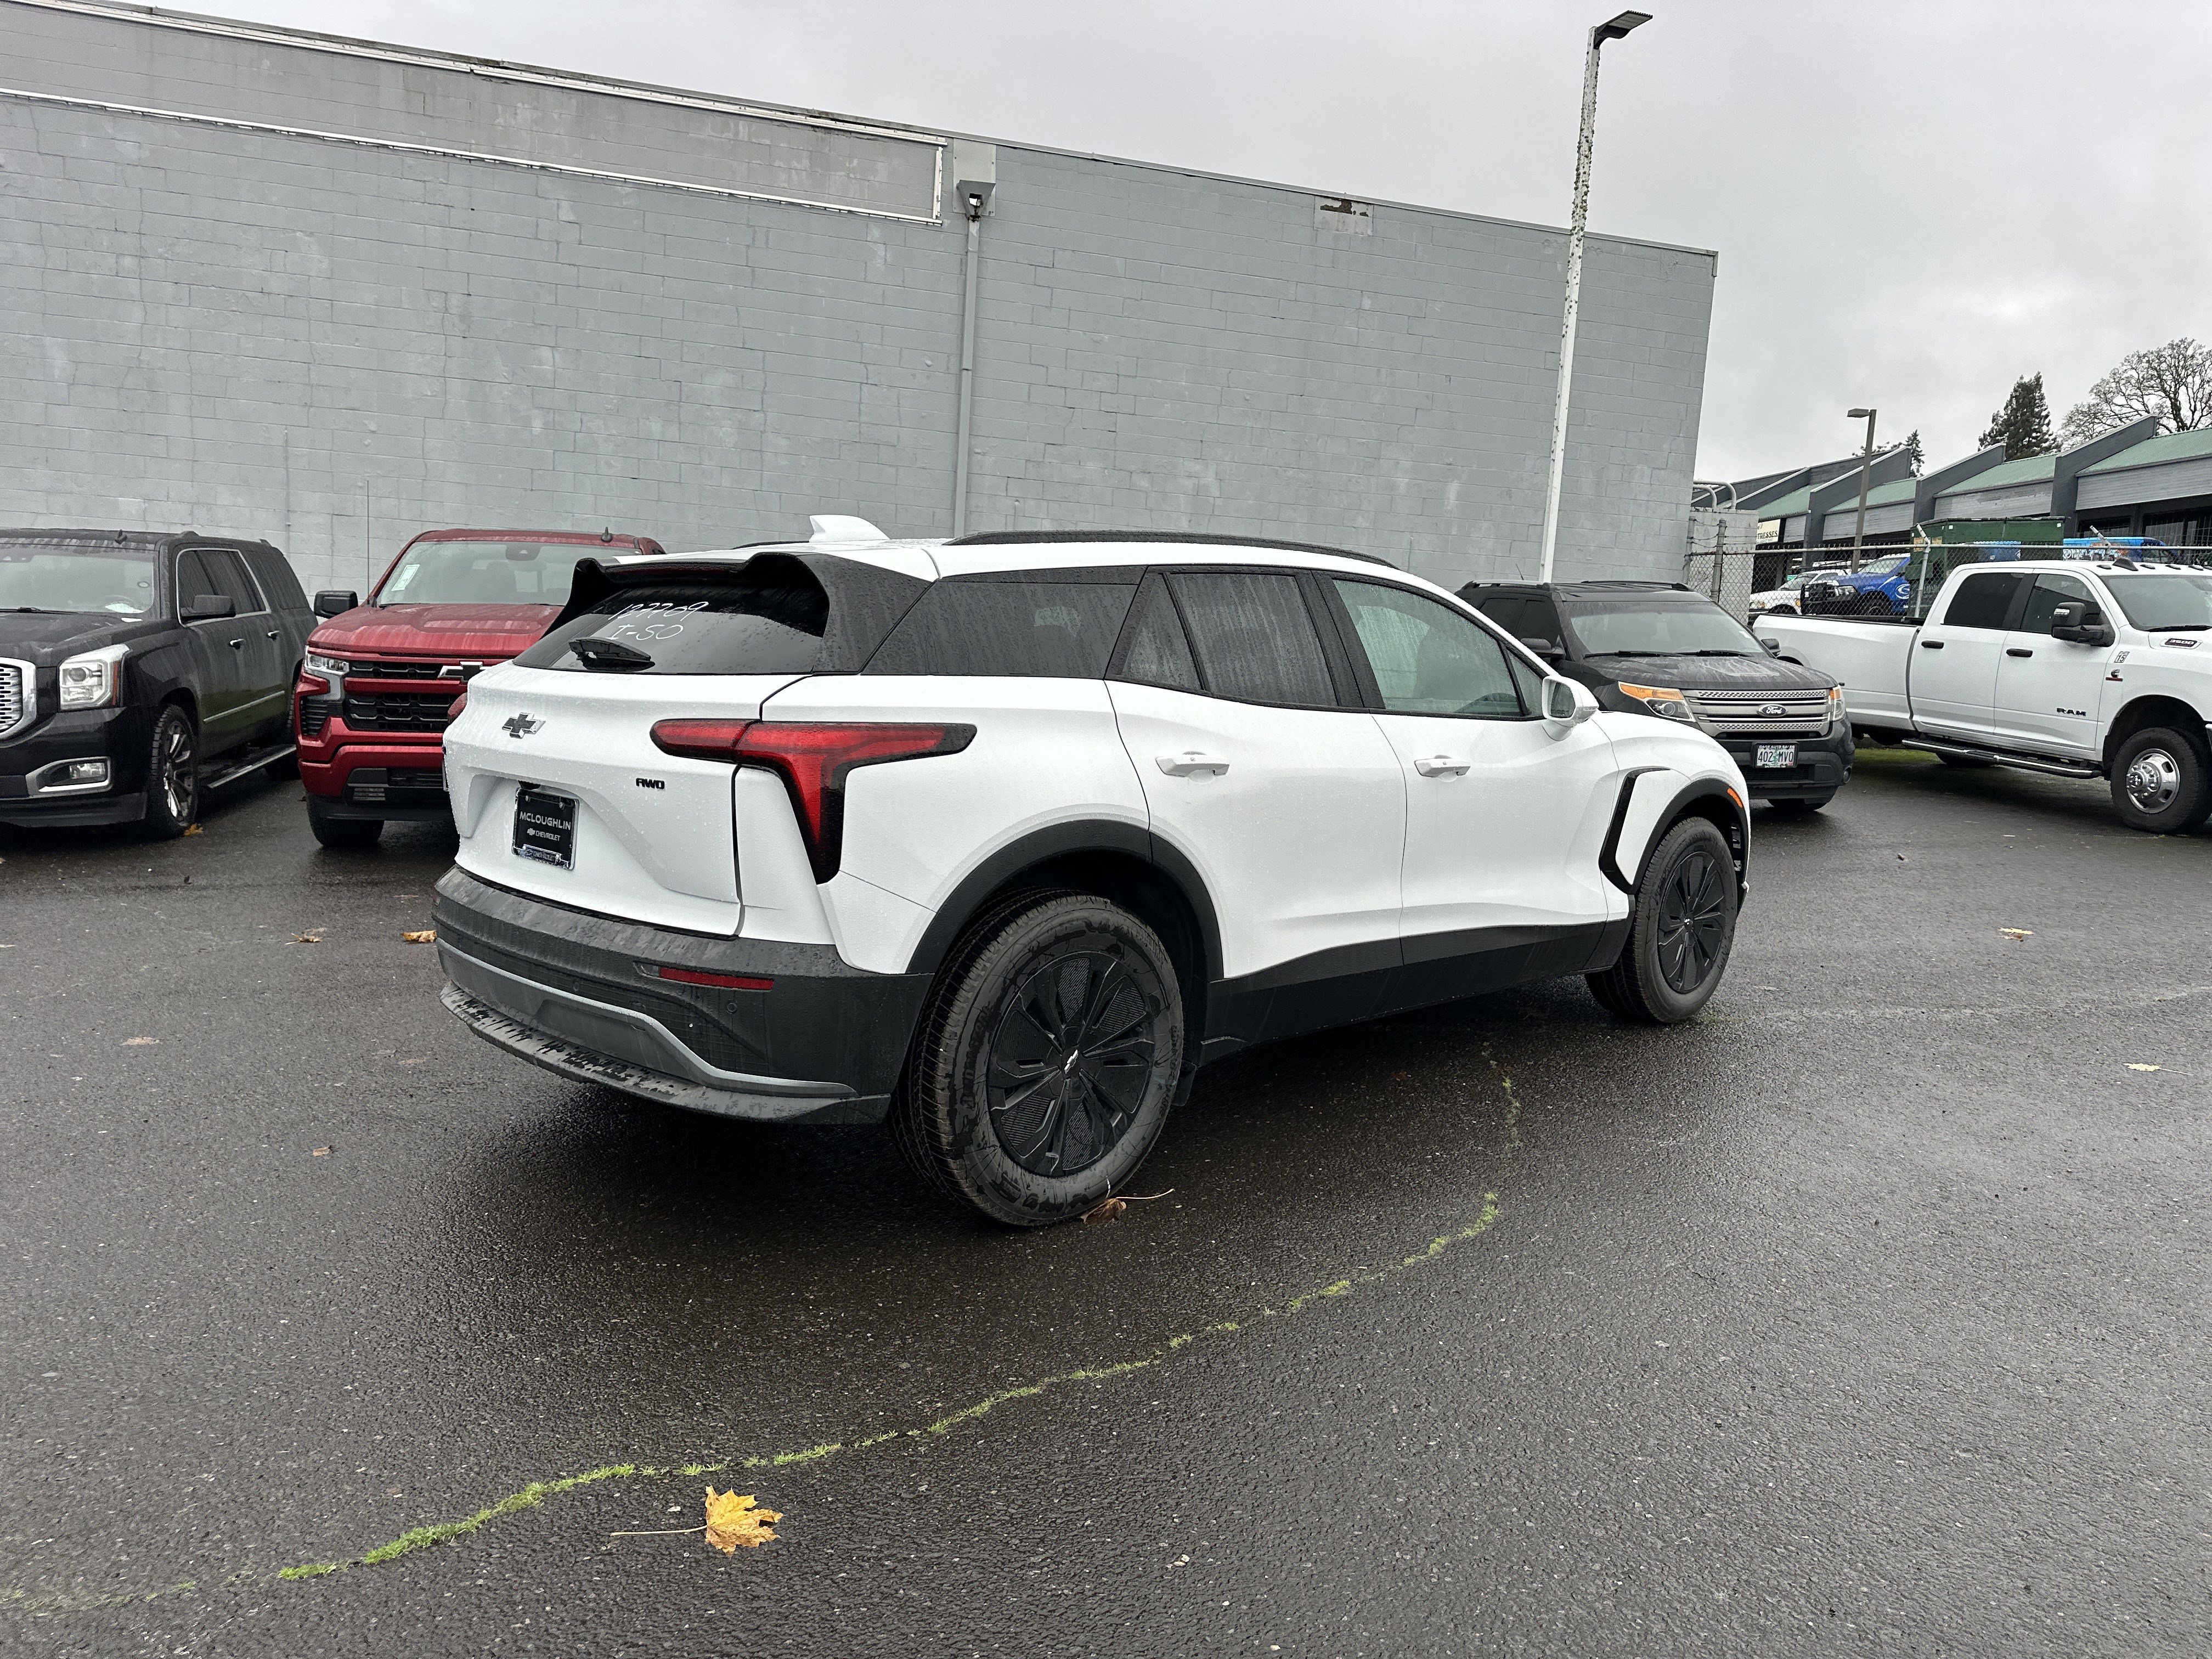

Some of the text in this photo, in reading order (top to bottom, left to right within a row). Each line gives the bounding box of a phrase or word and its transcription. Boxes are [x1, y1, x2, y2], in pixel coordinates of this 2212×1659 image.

[1766, 706, 1783, 714] Ford
[2057, 707, 2086, 716] RAM
[1758, 751, 1793, 763] 402 MVQ
[519, 811, 571, 831] MCLOUGHLIN
[535, 830, 561, 841] CHEVROLET
